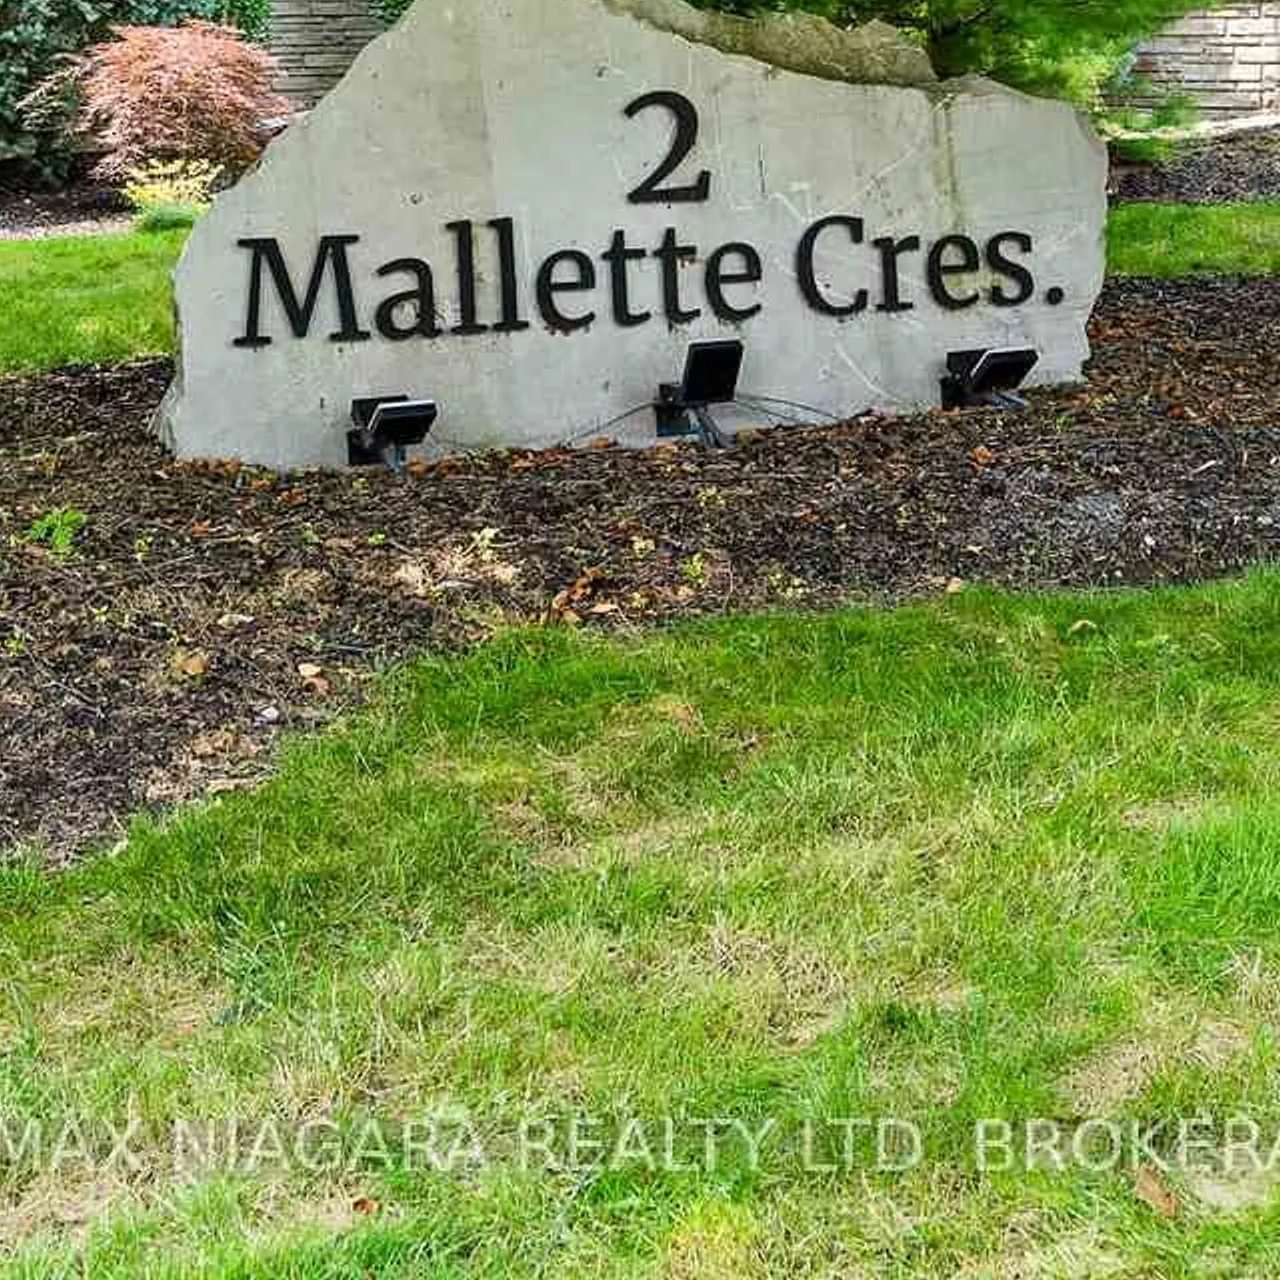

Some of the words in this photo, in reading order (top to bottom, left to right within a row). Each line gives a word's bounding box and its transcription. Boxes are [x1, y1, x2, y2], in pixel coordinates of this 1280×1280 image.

[623, 90, 710, 203] 2
[233, 217, 762, 347] Mallette
[796, 215, 1065, 317] Cres.
